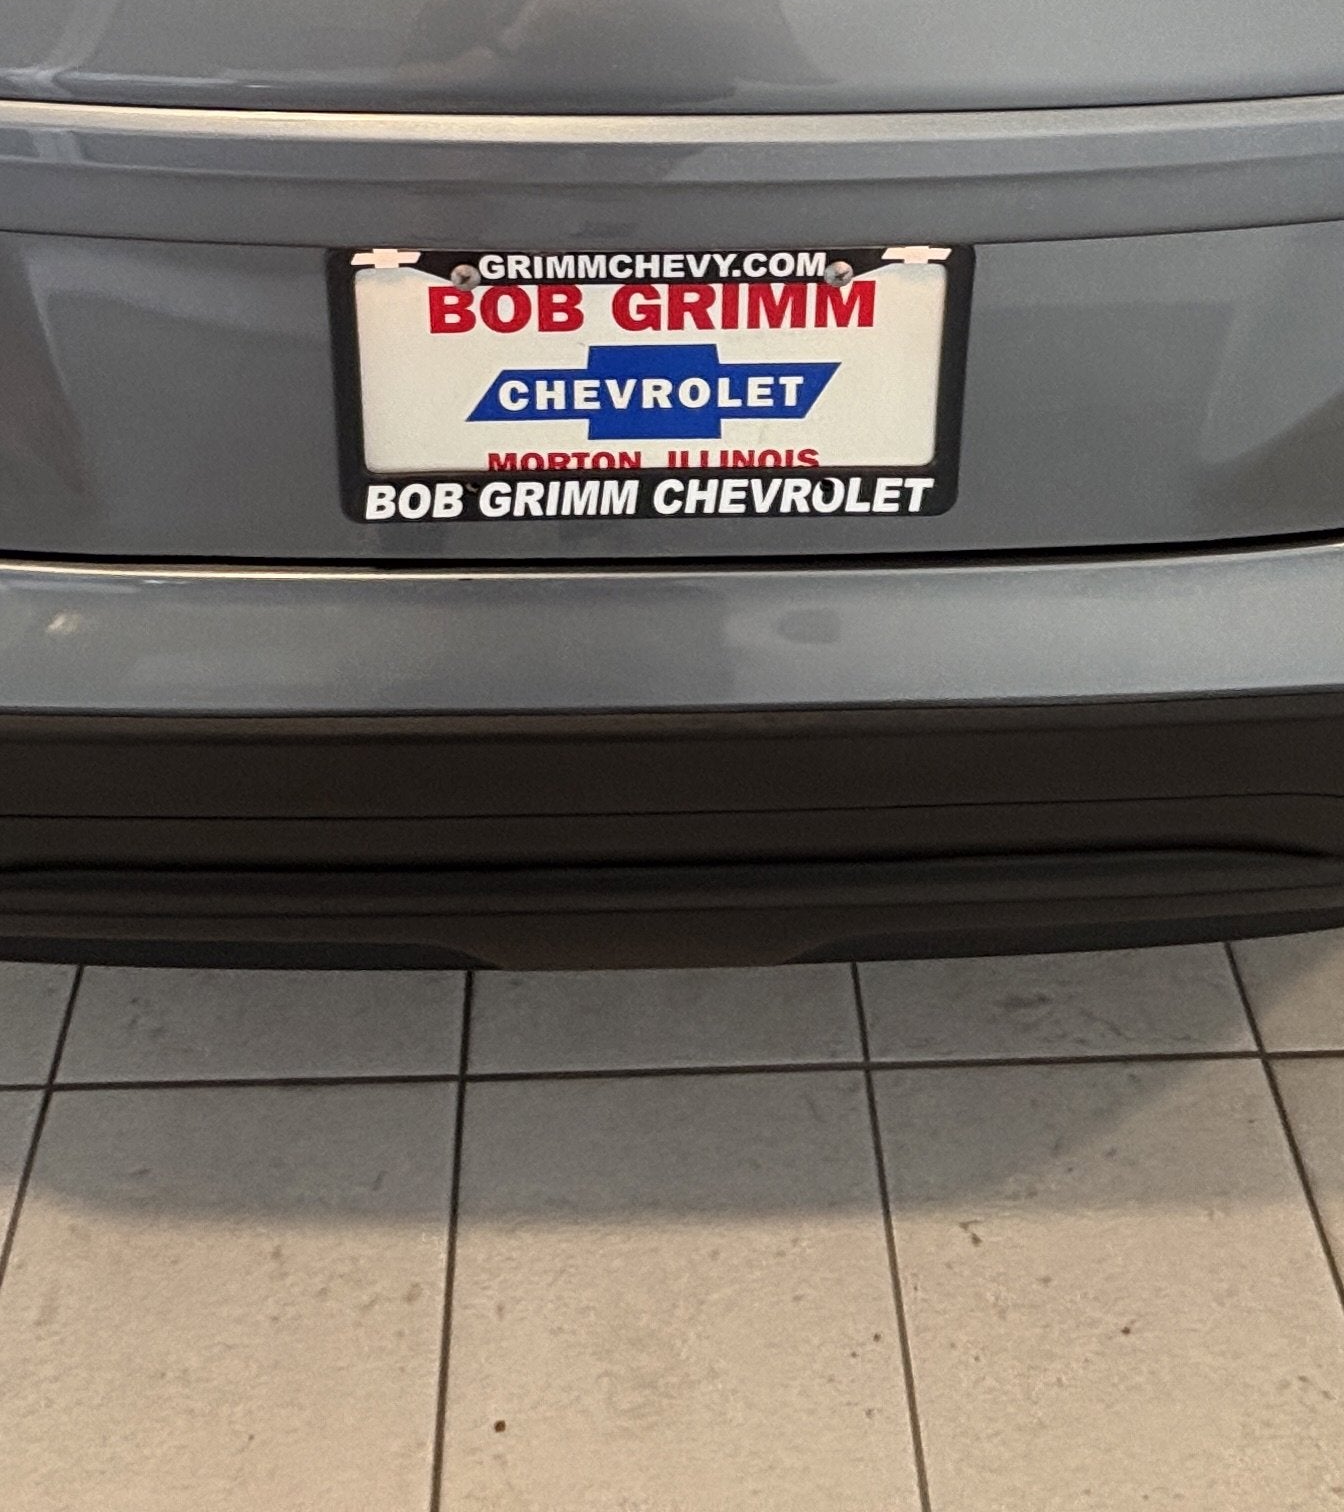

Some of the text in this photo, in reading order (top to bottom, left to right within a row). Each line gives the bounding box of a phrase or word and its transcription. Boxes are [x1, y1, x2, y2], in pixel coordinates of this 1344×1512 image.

[478, 251, 827, 280] GRIMMCHEVY.COM
[428, 280, 877, 334] BOB GRIMM
[498, 375, 805, 412] CHEVROLET
[487, 451, 642, 472] MORTON
[365, 477, 935, 520] BOB GRIMM CHEVROLET
